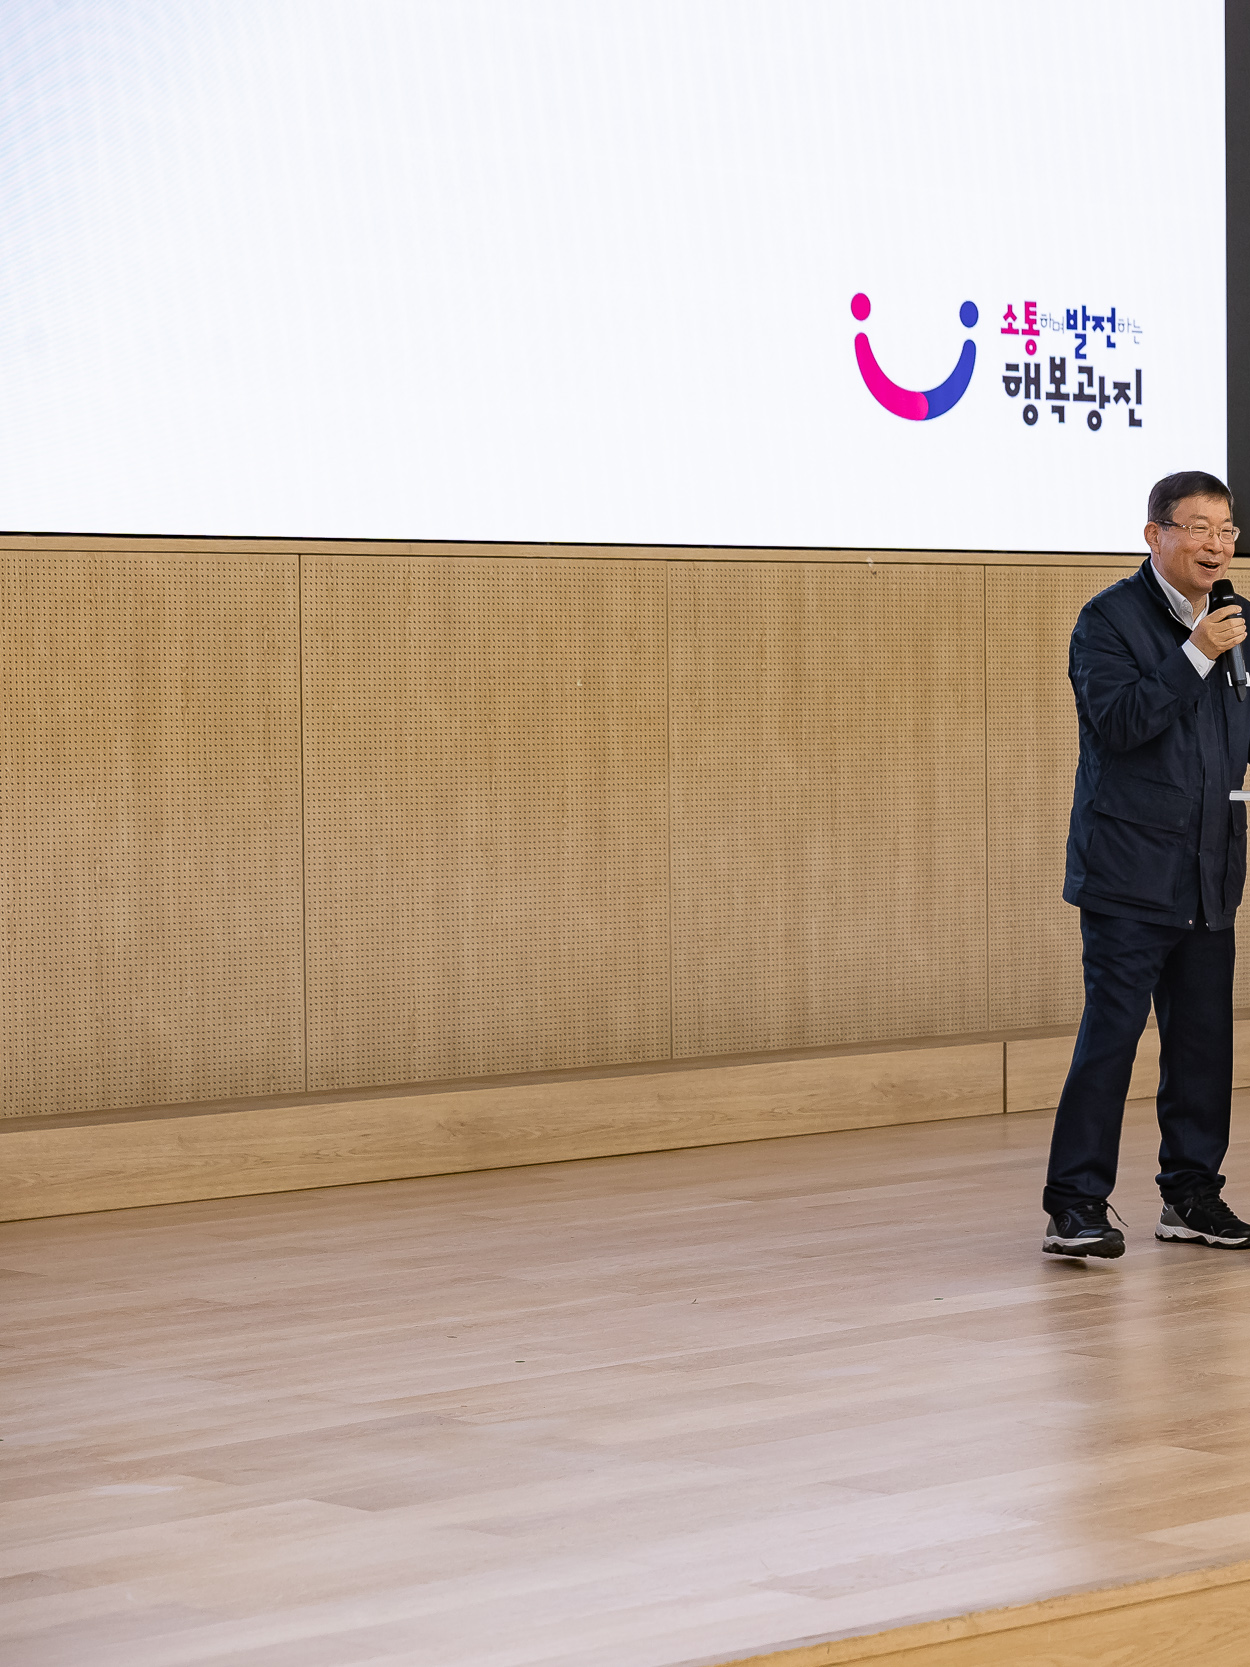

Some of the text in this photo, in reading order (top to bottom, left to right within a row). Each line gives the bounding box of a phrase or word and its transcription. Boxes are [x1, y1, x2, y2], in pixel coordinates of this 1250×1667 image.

[1000, 301, 1143, 360] 소통하며 발전하는
[1002, 356, 1142, 431] 행복광진
